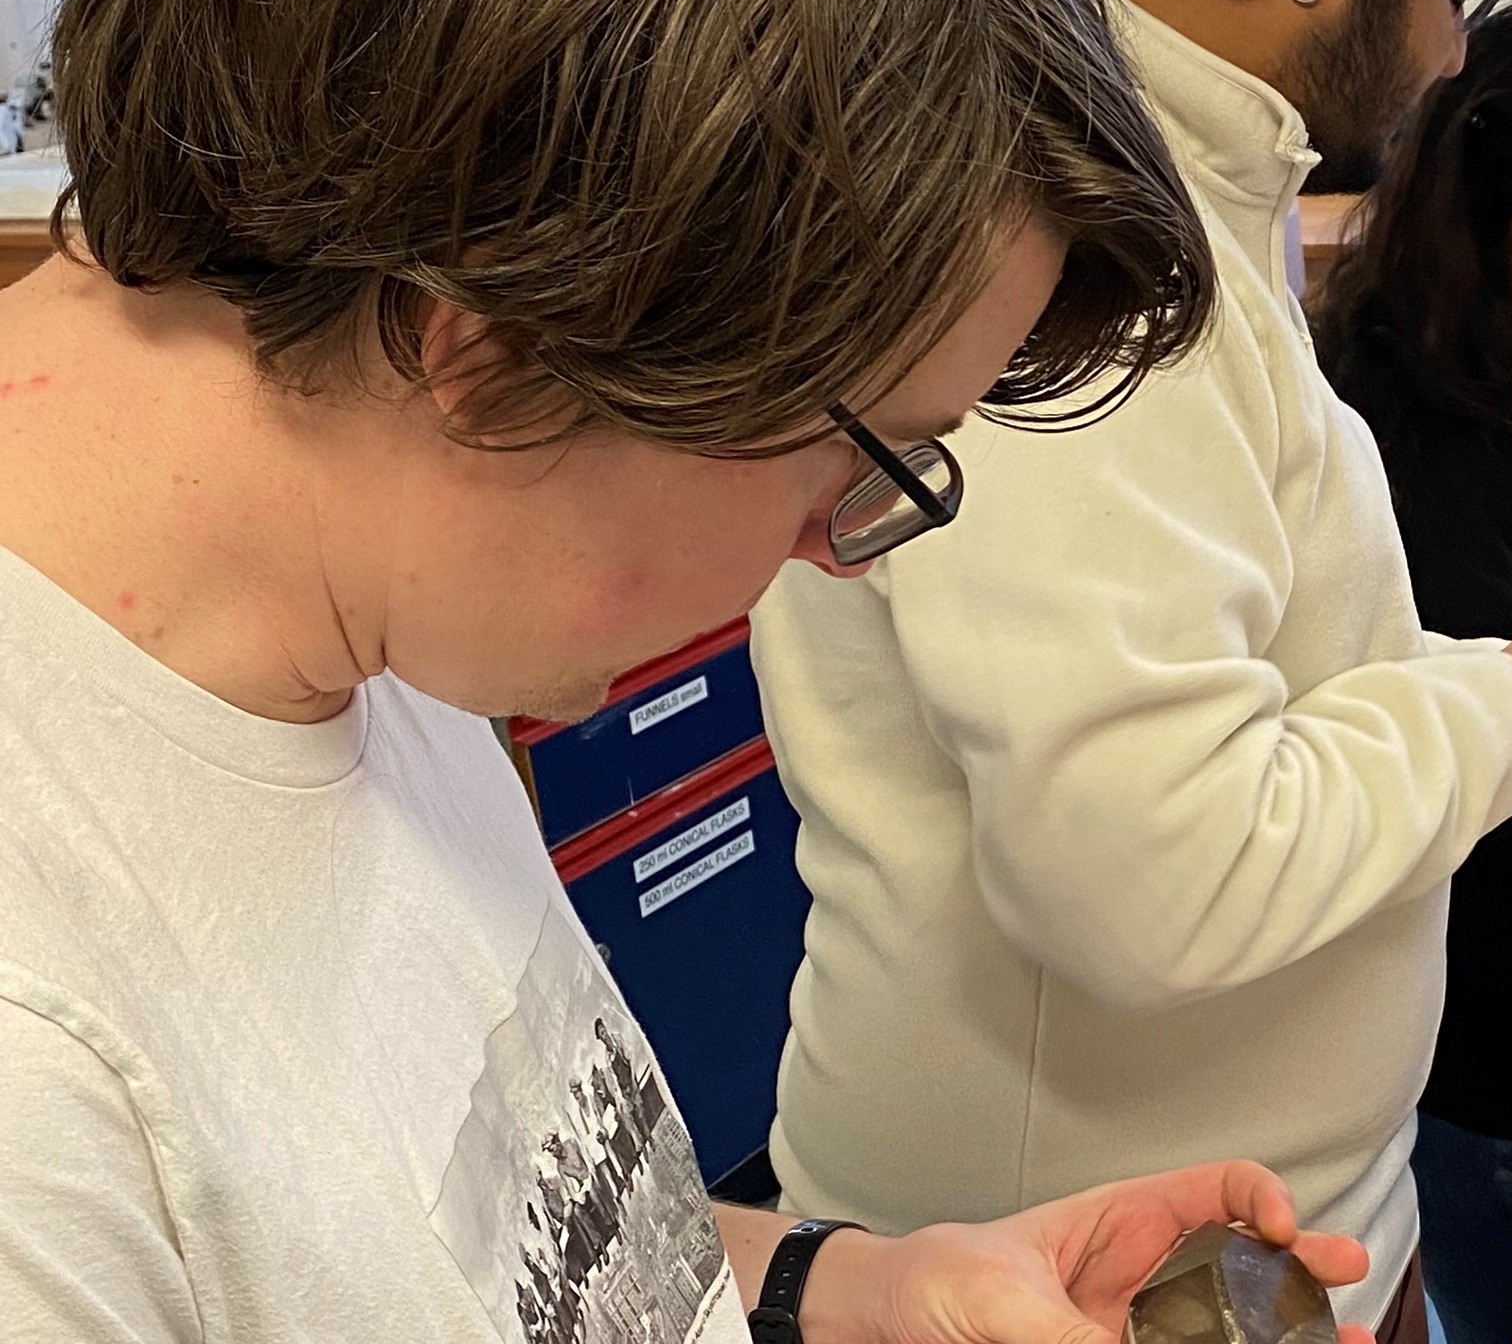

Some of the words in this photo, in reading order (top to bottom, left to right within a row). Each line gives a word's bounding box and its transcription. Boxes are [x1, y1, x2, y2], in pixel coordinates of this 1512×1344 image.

[634, 694, 679, 726] FUNNELS
[638, 856, 657, 875] 250
[668, 827, 709, 856] CONICAL
[709, 803, 746, 836] FLASKS
[644, 889, 661, 909] 500
[673, 860, 715, 890] CONICAL
[714, 838, 750, 869] FLASKS
